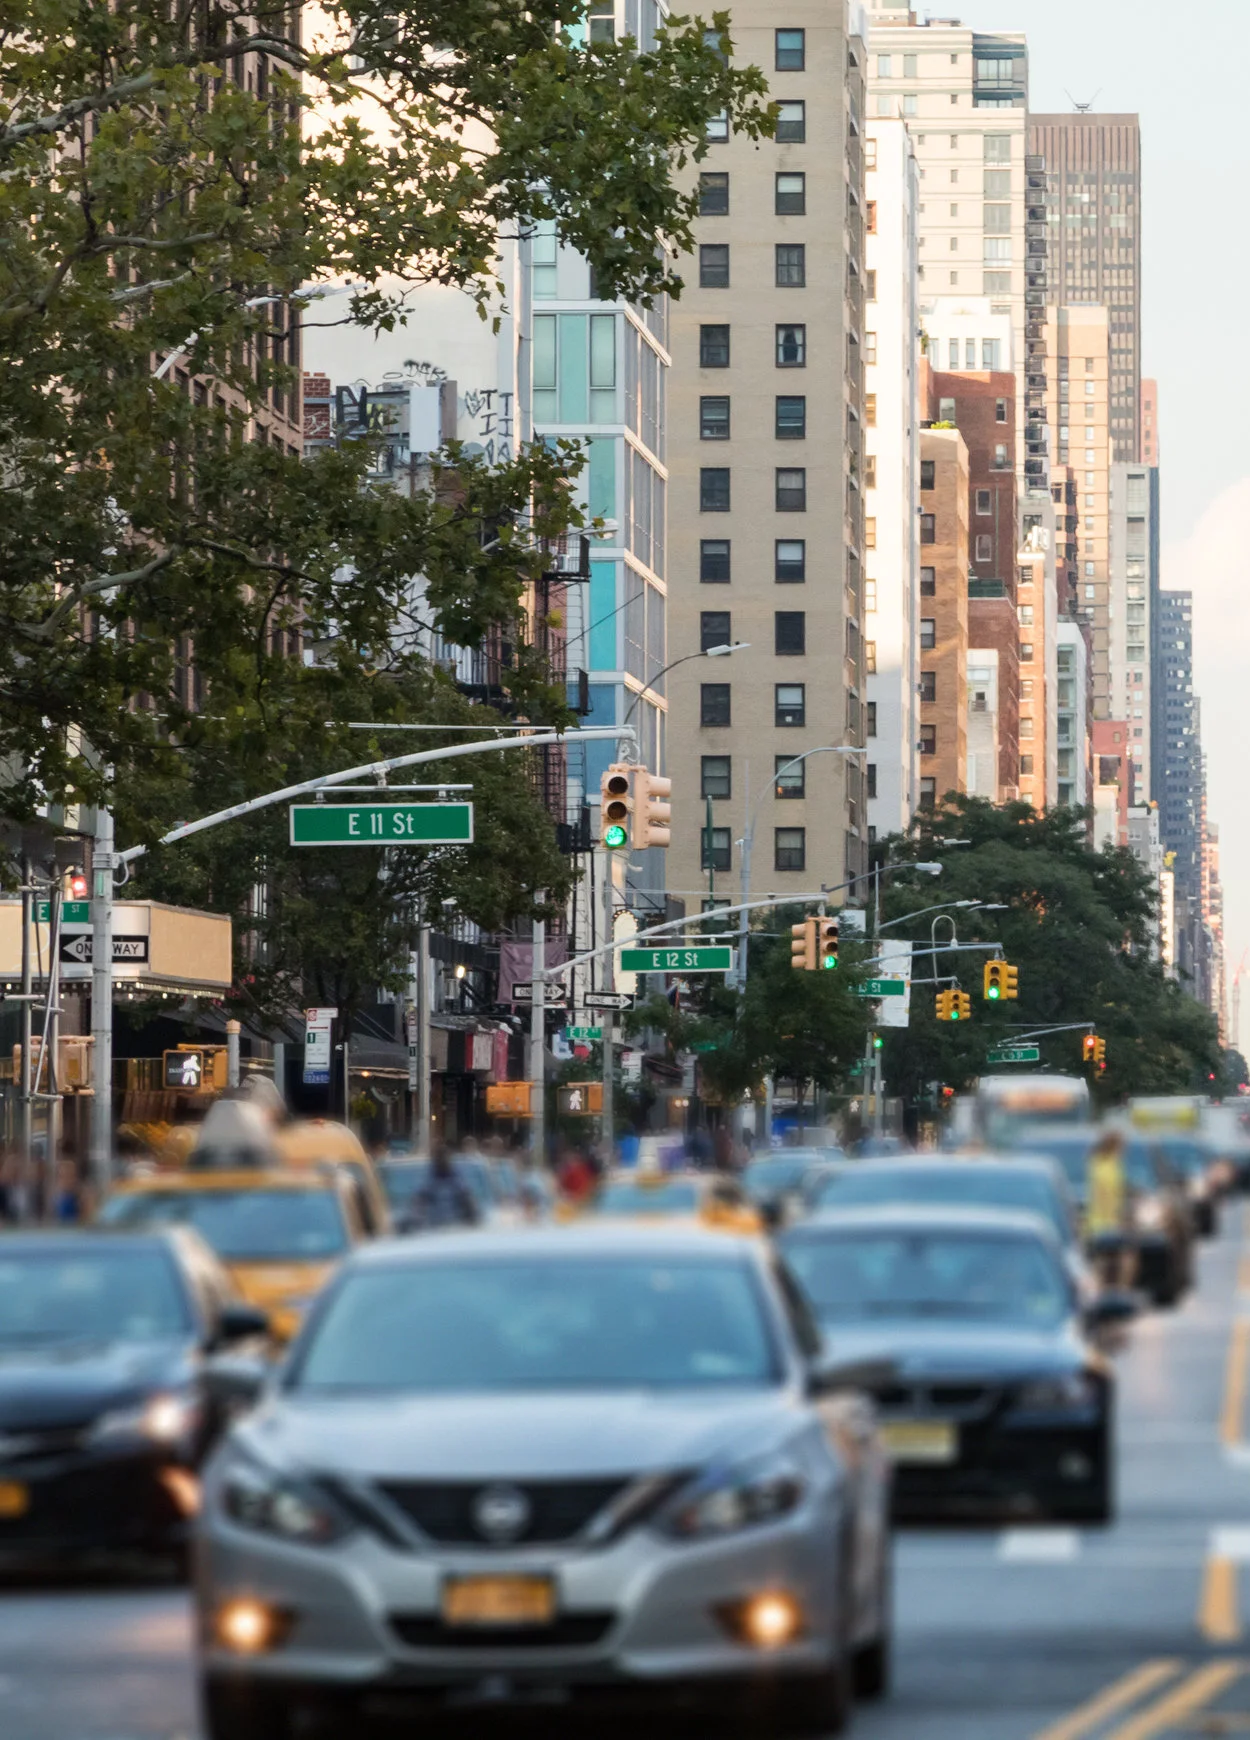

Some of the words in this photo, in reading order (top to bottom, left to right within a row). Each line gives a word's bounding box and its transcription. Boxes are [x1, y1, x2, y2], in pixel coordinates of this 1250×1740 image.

[349, 813, 361, 835] E
[370, 813, 383, 835] 11
[393, 812, 415, 835] St
[38, 904, 47, 920] E
[71, 904, 80, 913] ST
[75, 943, 93, 955] ON
[112, 943, 139, 955] WAY
[652, 952, 661, 967] E
[666, 952, 679, 967] 12
[684, 952, 699, 967] St
[570, 1028, 576, 1038] E
